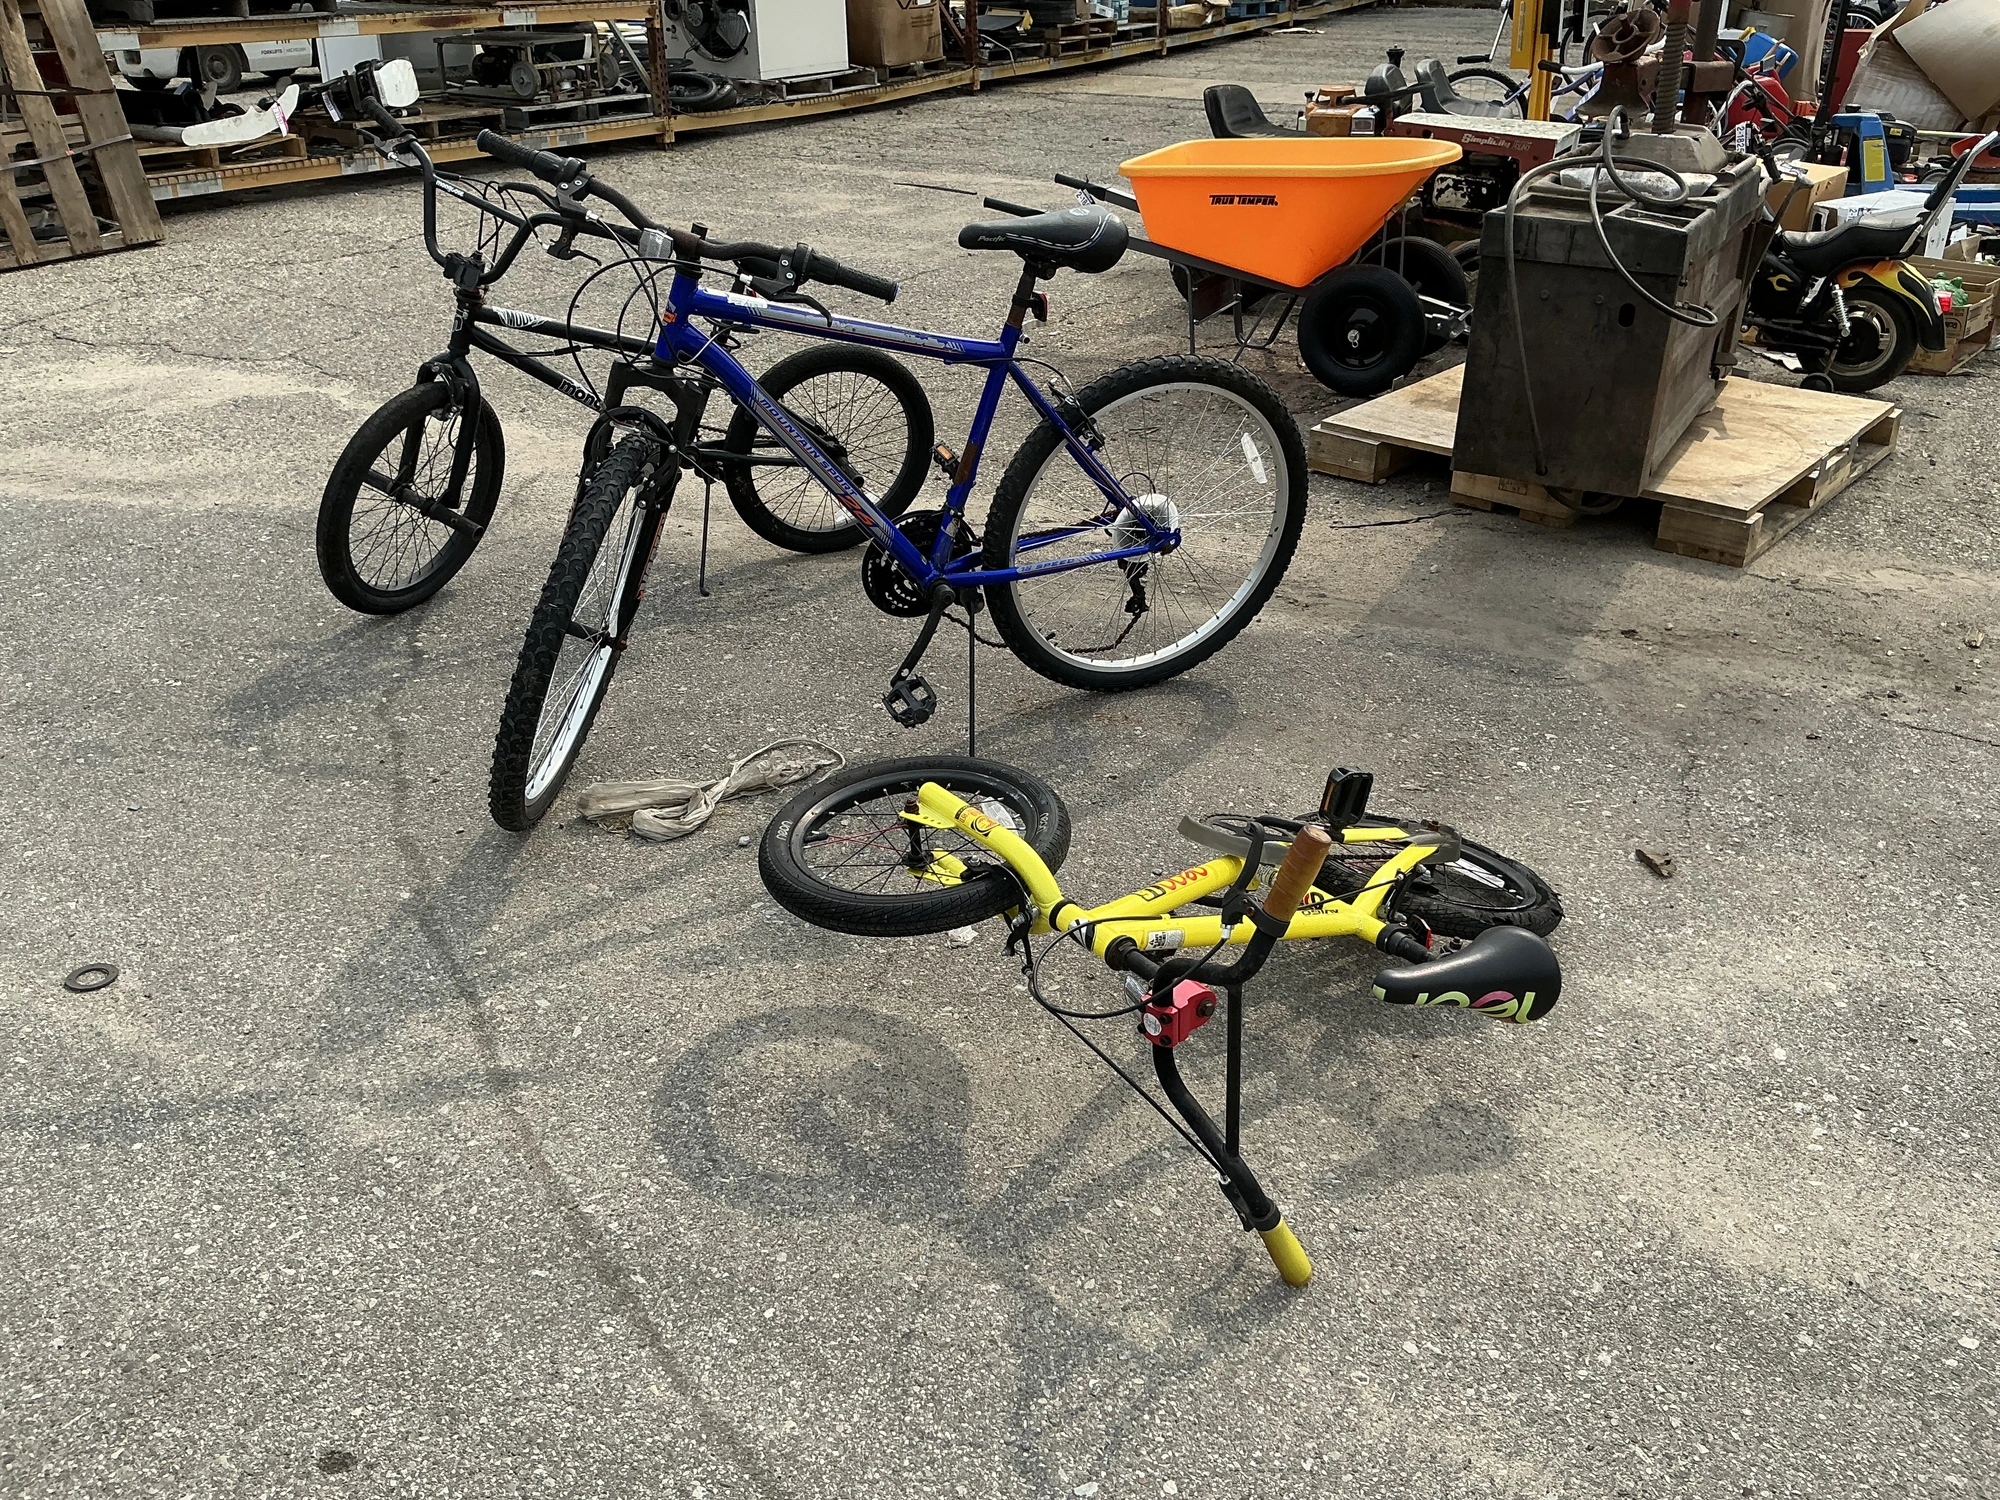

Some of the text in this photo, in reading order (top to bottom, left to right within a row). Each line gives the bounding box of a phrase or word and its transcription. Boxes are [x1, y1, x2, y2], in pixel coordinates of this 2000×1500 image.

[1209, 195, 1236, 206] TRUE
[977, 235, 1007, 243] Pacific
[759, 398, 859, 497] MOUNTAIN SPORT
[838, 492, 879, 527] 26
[1035, 558, 1075, 570] SPEED
[776, 820, 794, 841] neon
